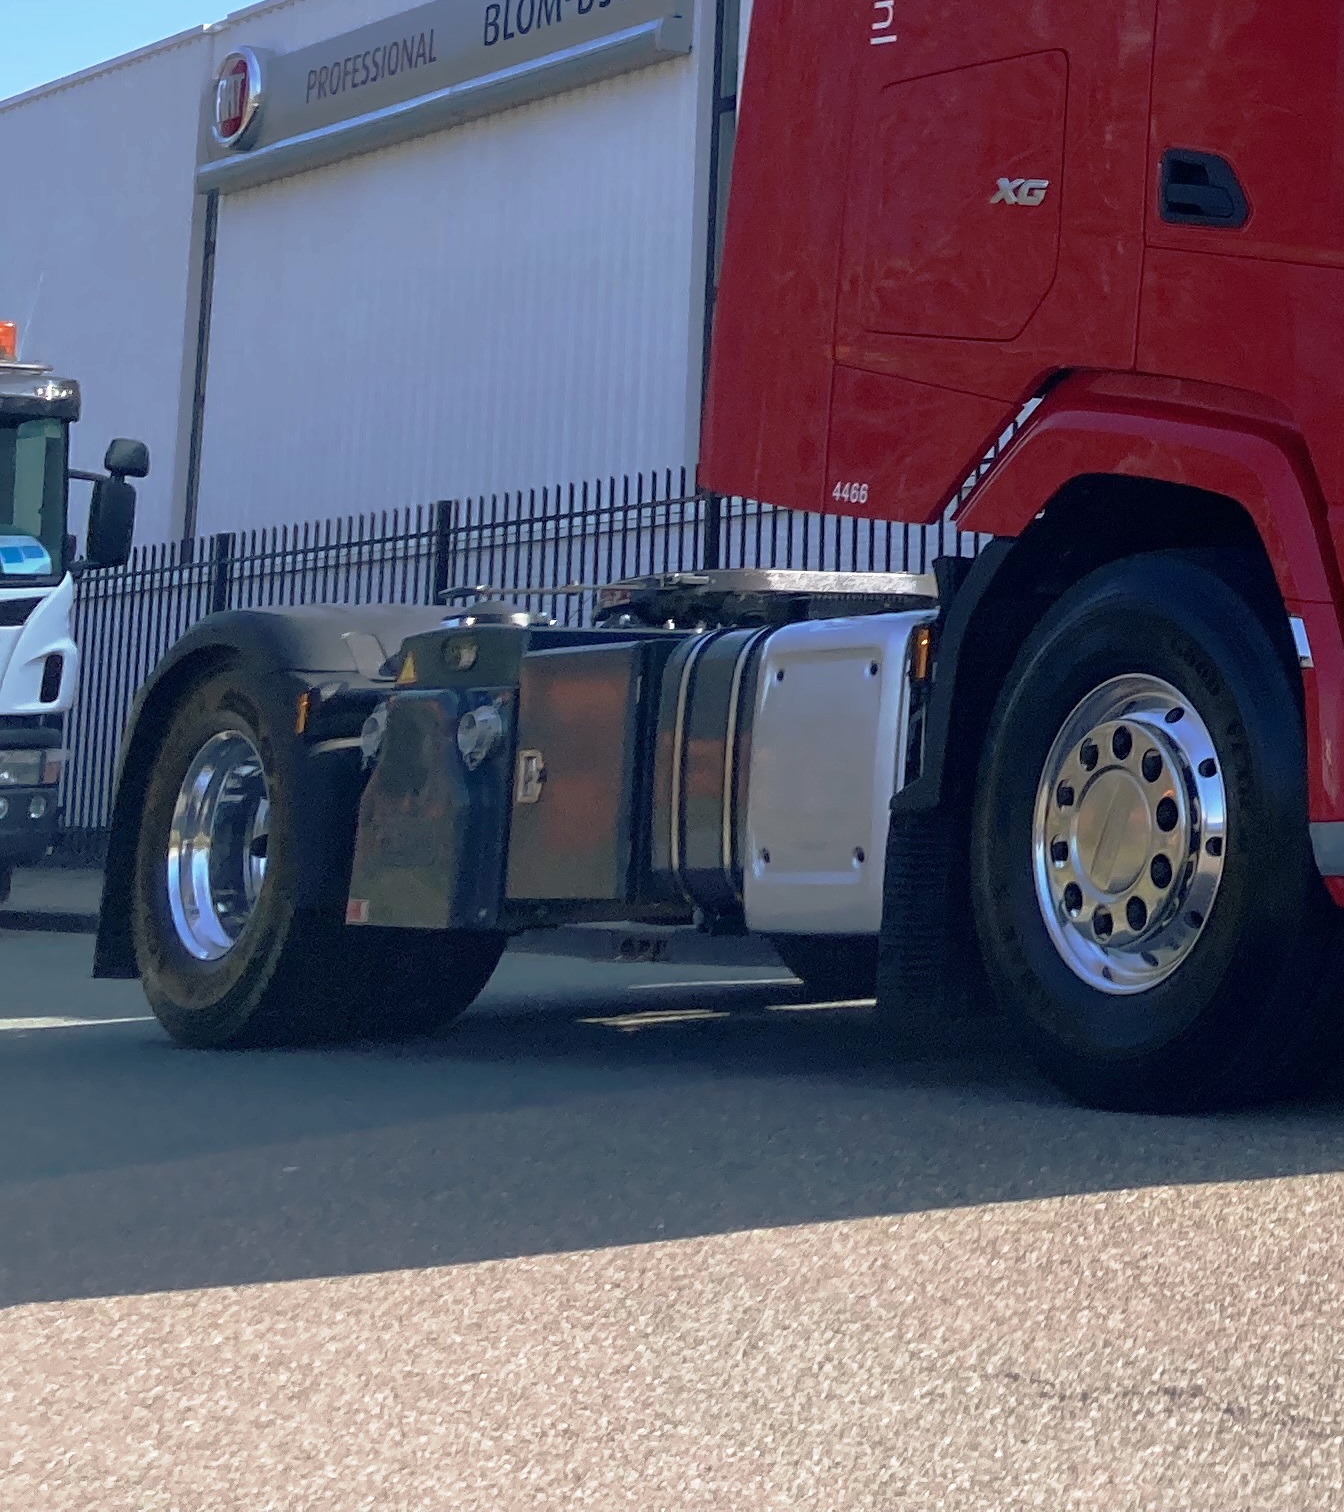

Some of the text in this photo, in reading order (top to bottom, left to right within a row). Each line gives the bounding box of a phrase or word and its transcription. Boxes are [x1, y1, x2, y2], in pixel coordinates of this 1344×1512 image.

[305, 28, 438, 105] PROFESSIONAL
[990, 177, 1050, 206] XG
[832, 481, 869, 504] 4466
